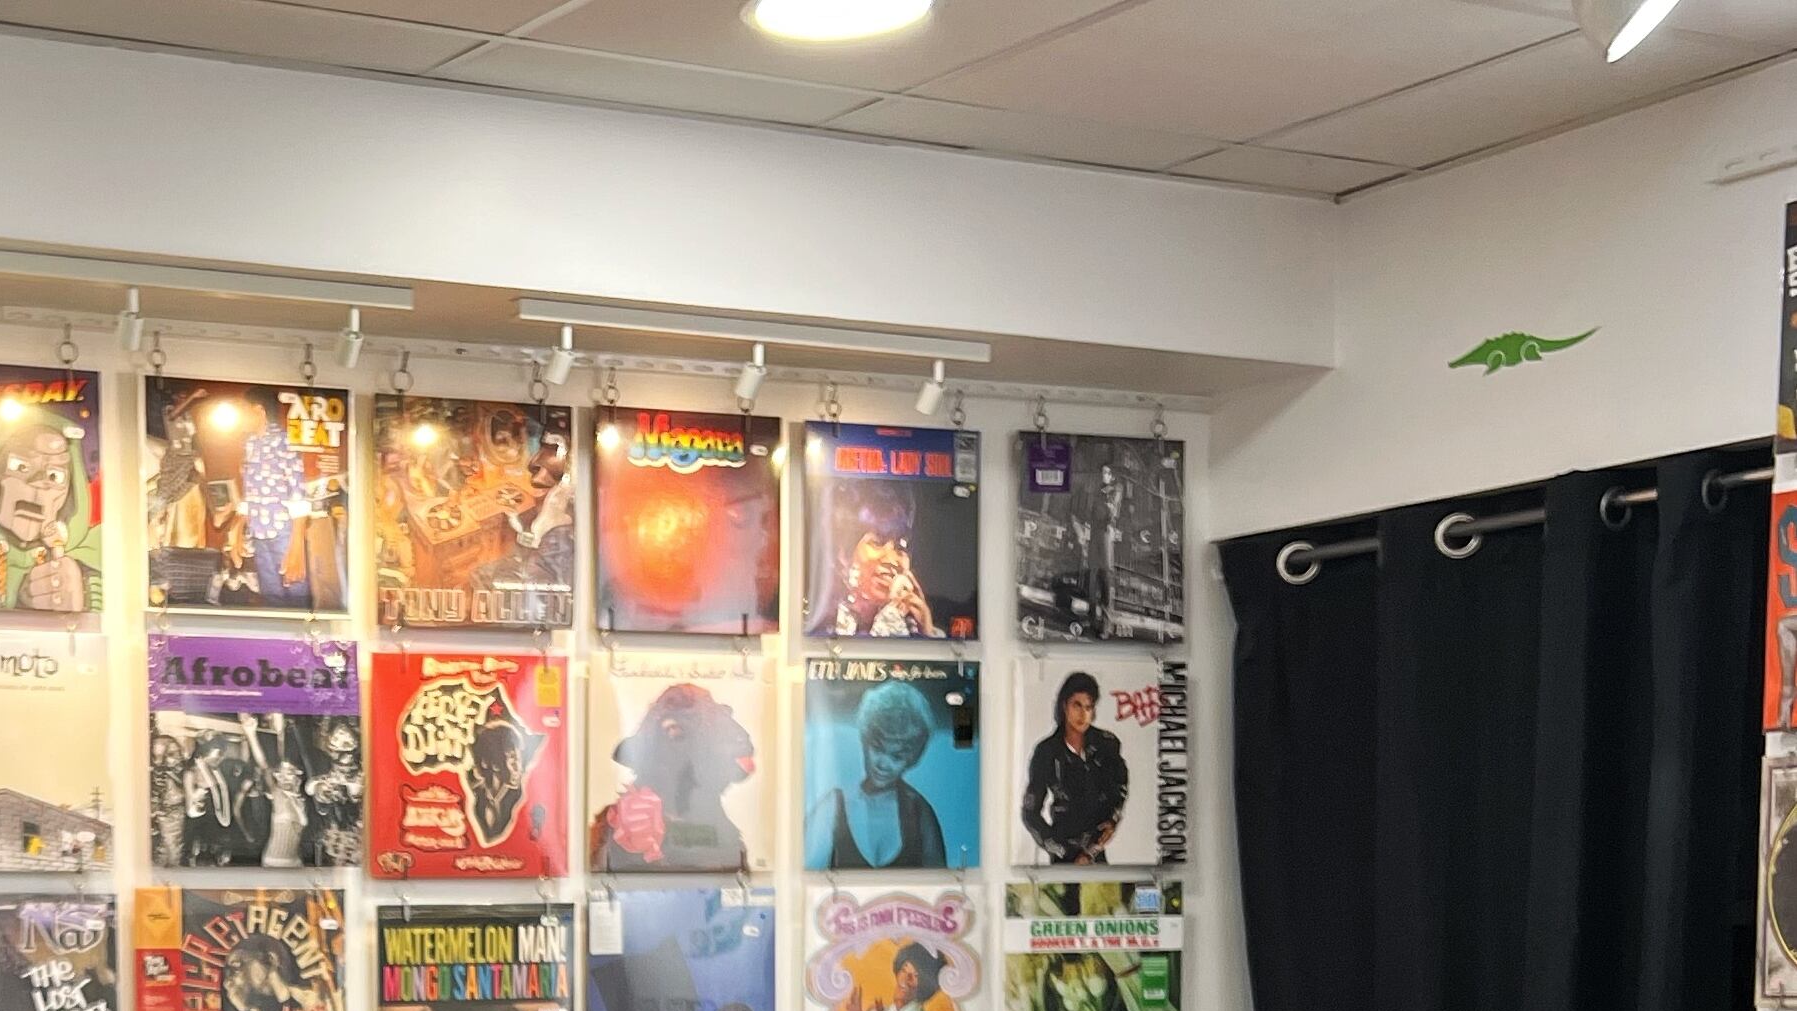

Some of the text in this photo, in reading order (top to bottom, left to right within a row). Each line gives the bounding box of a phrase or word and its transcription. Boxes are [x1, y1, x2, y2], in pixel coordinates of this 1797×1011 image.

[1157, 661, 1187, 864] MICHAEL JACKSON
[383, 925, 514, 964] WATERMELON
[517, 925, 568, 963] MAN!
[1030, 919, 1159, 937] GREEN ONIONS
[382, 962, 569, 1001] MONGO SANTAMARIA
